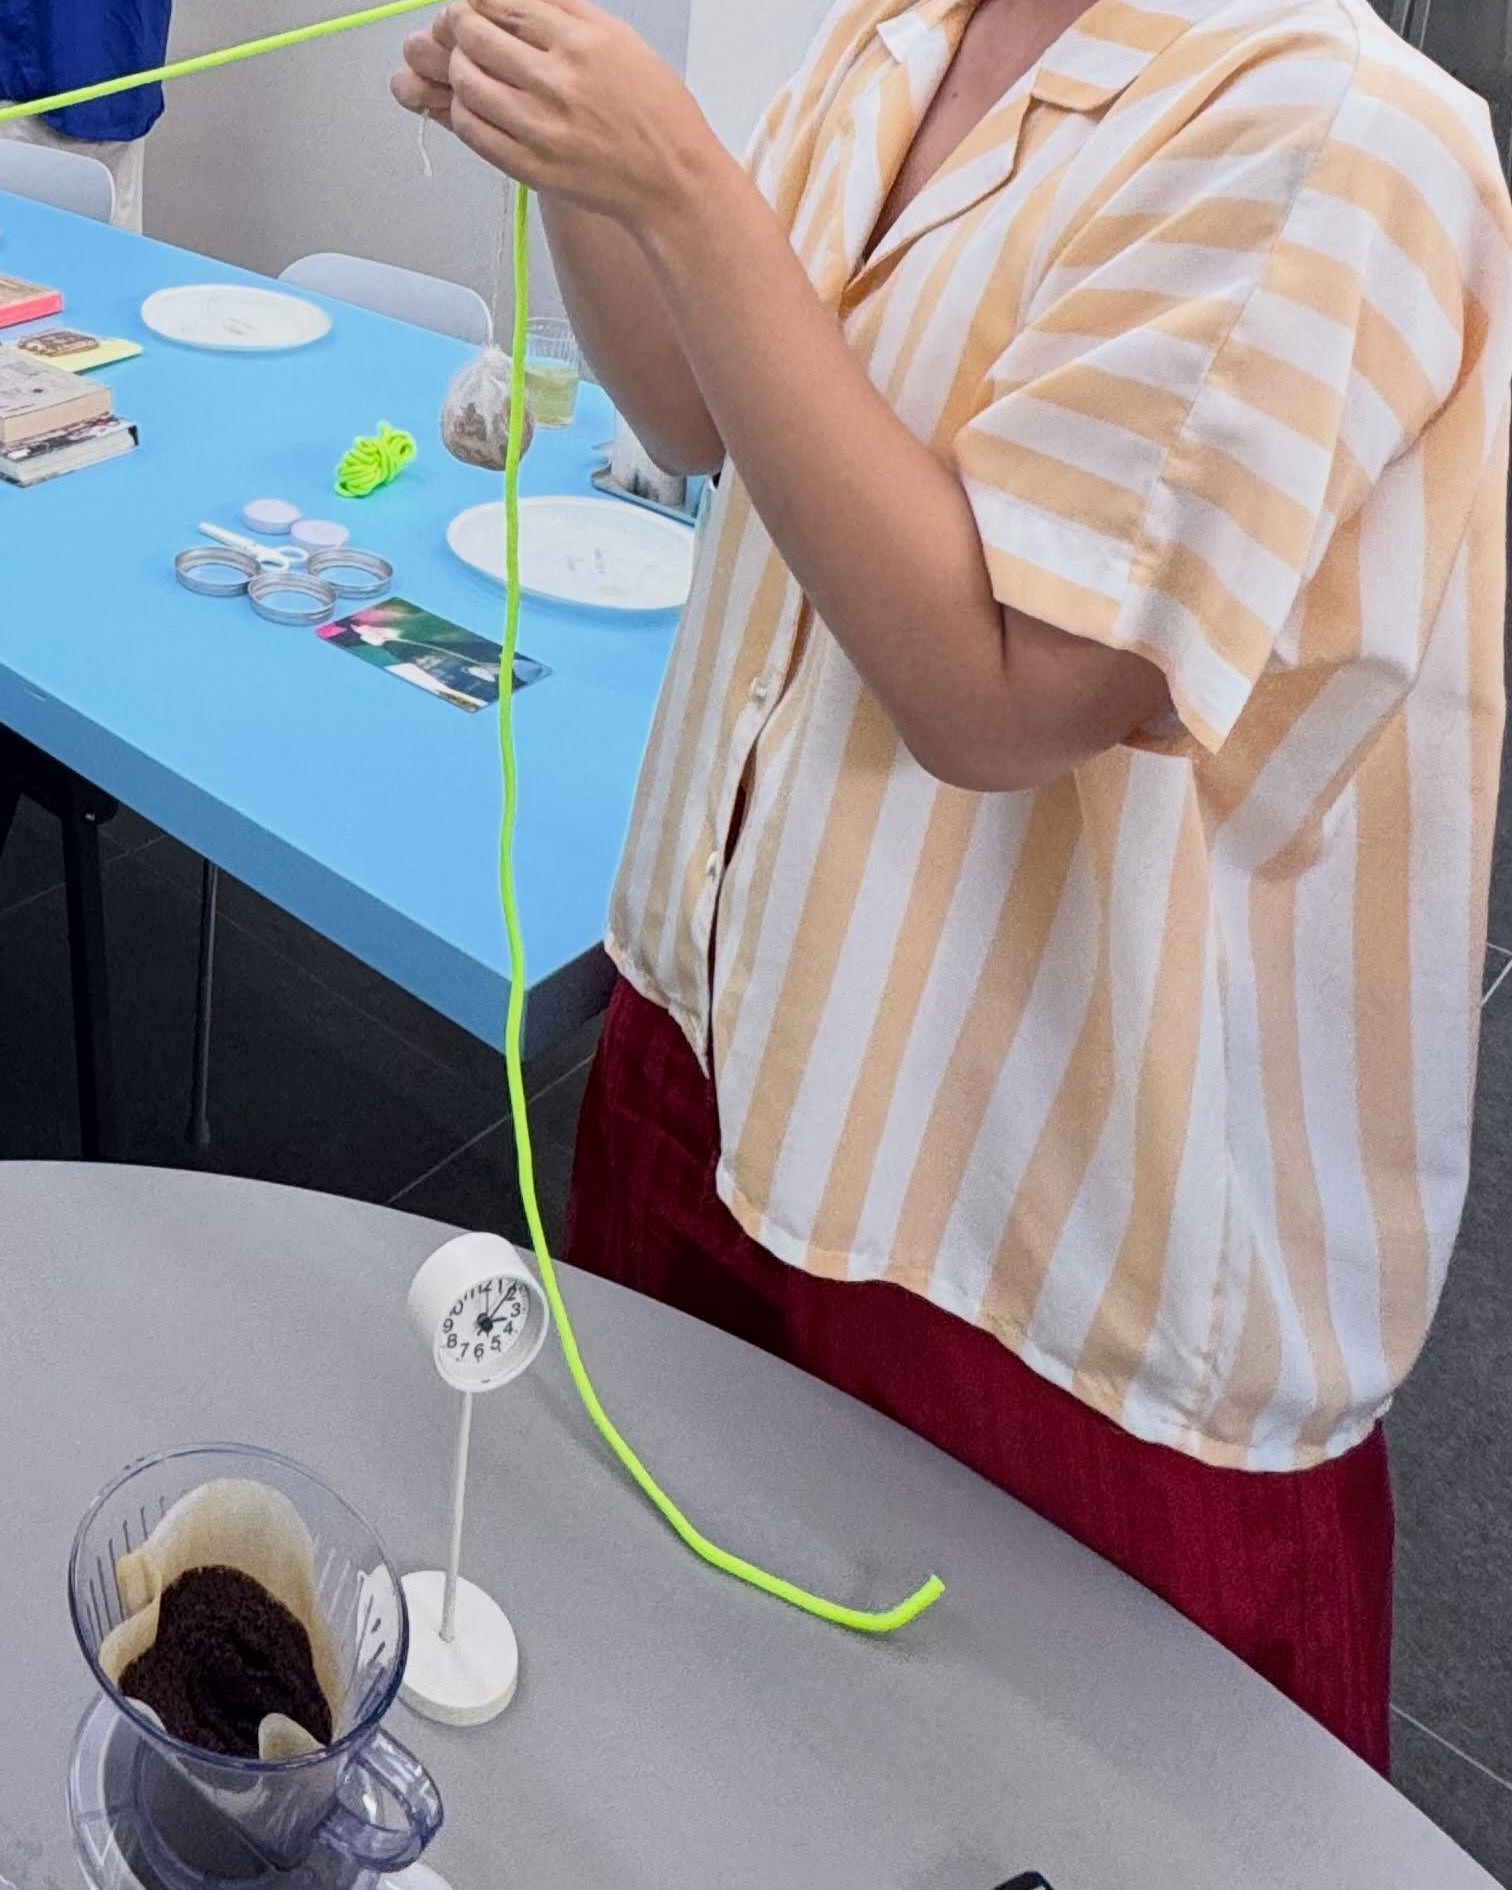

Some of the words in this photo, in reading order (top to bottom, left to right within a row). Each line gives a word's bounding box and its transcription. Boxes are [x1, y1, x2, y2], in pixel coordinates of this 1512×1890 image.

[510, 1302, 521, 1317] 3
[443, 1318, 454, 1334] 9
[503, 1320, 513, 1335] 4
[447, 1333, 457, 1349] 8
[490, 1335, 501, 1351] 5
[461, 1342, 470, 1358] 7
[474, 1343, 484, 1358] 6
